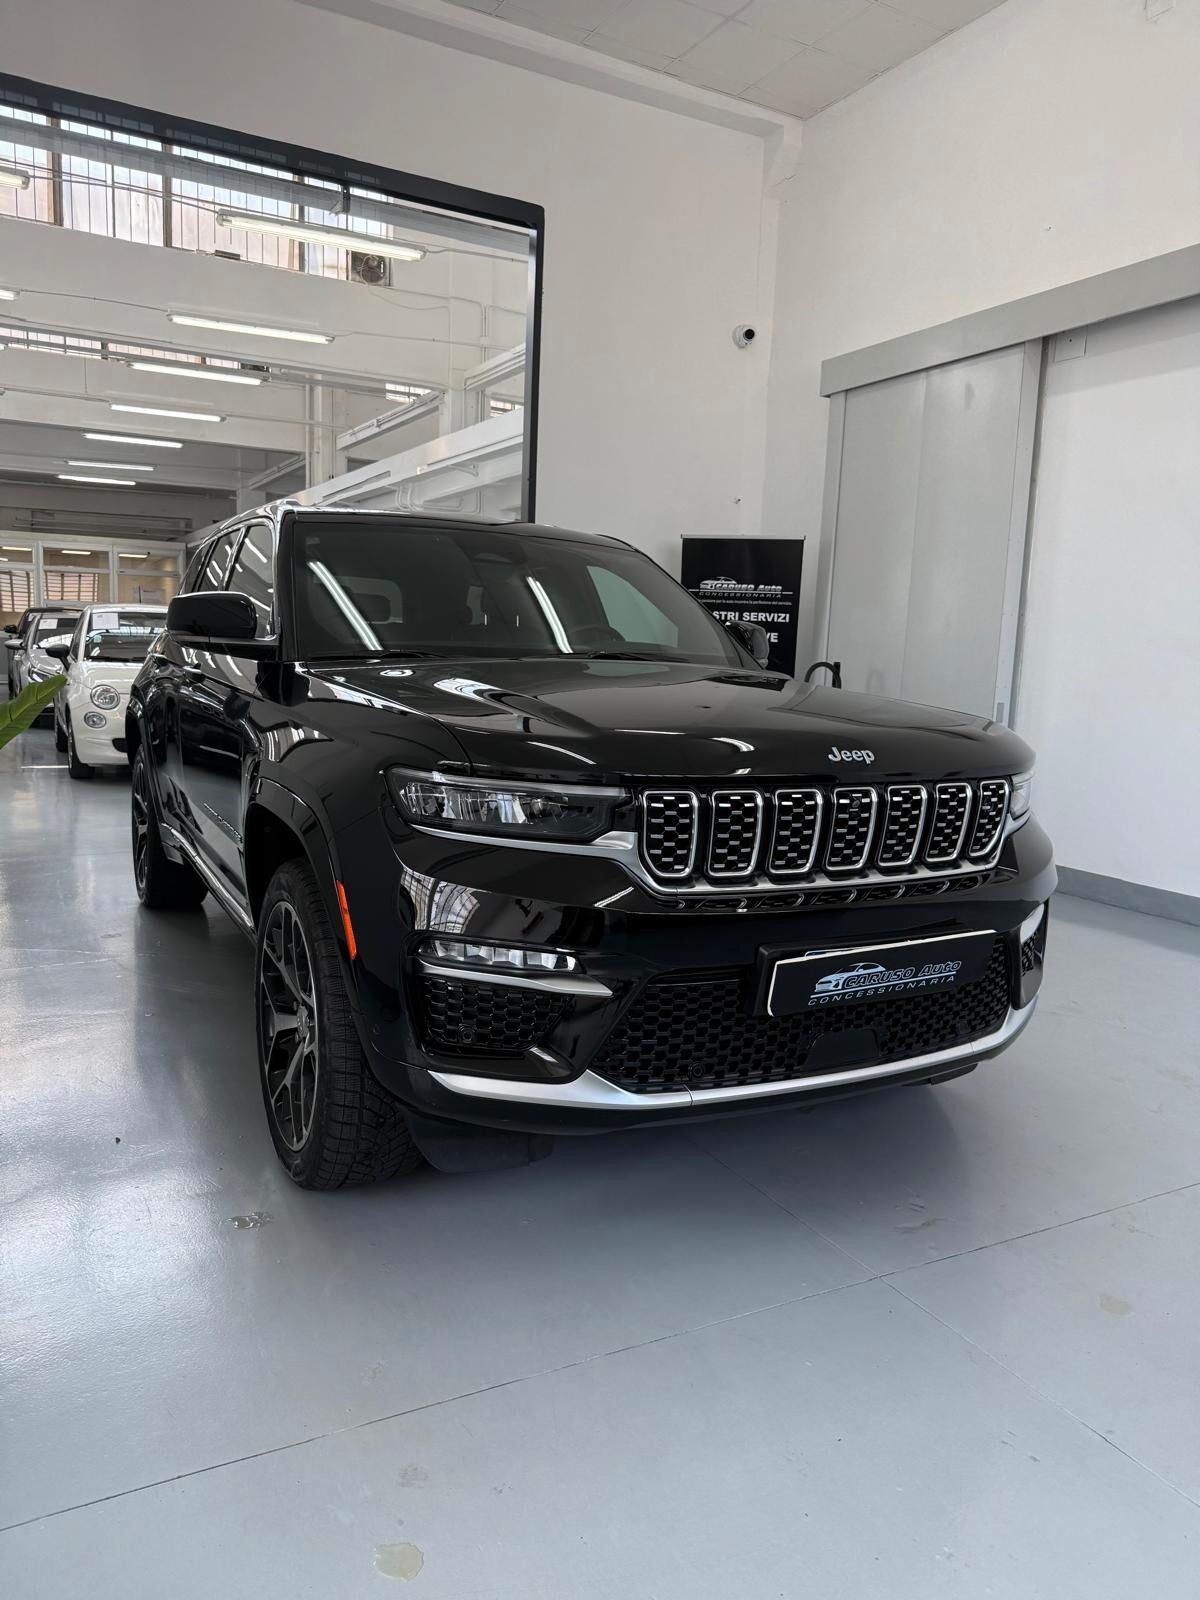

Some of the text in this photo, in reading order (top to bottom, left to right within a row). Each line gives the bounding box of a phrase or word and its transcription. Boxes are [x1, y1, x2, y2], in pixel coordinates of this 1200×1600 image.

[713, 611, 790, 622] STRI SERVIZI
[828, 746, 875, 764] Jeep
[844, 967, 916, 988] CARUSO
[808, 975, 955, 1006] CONCESSIONARIA
